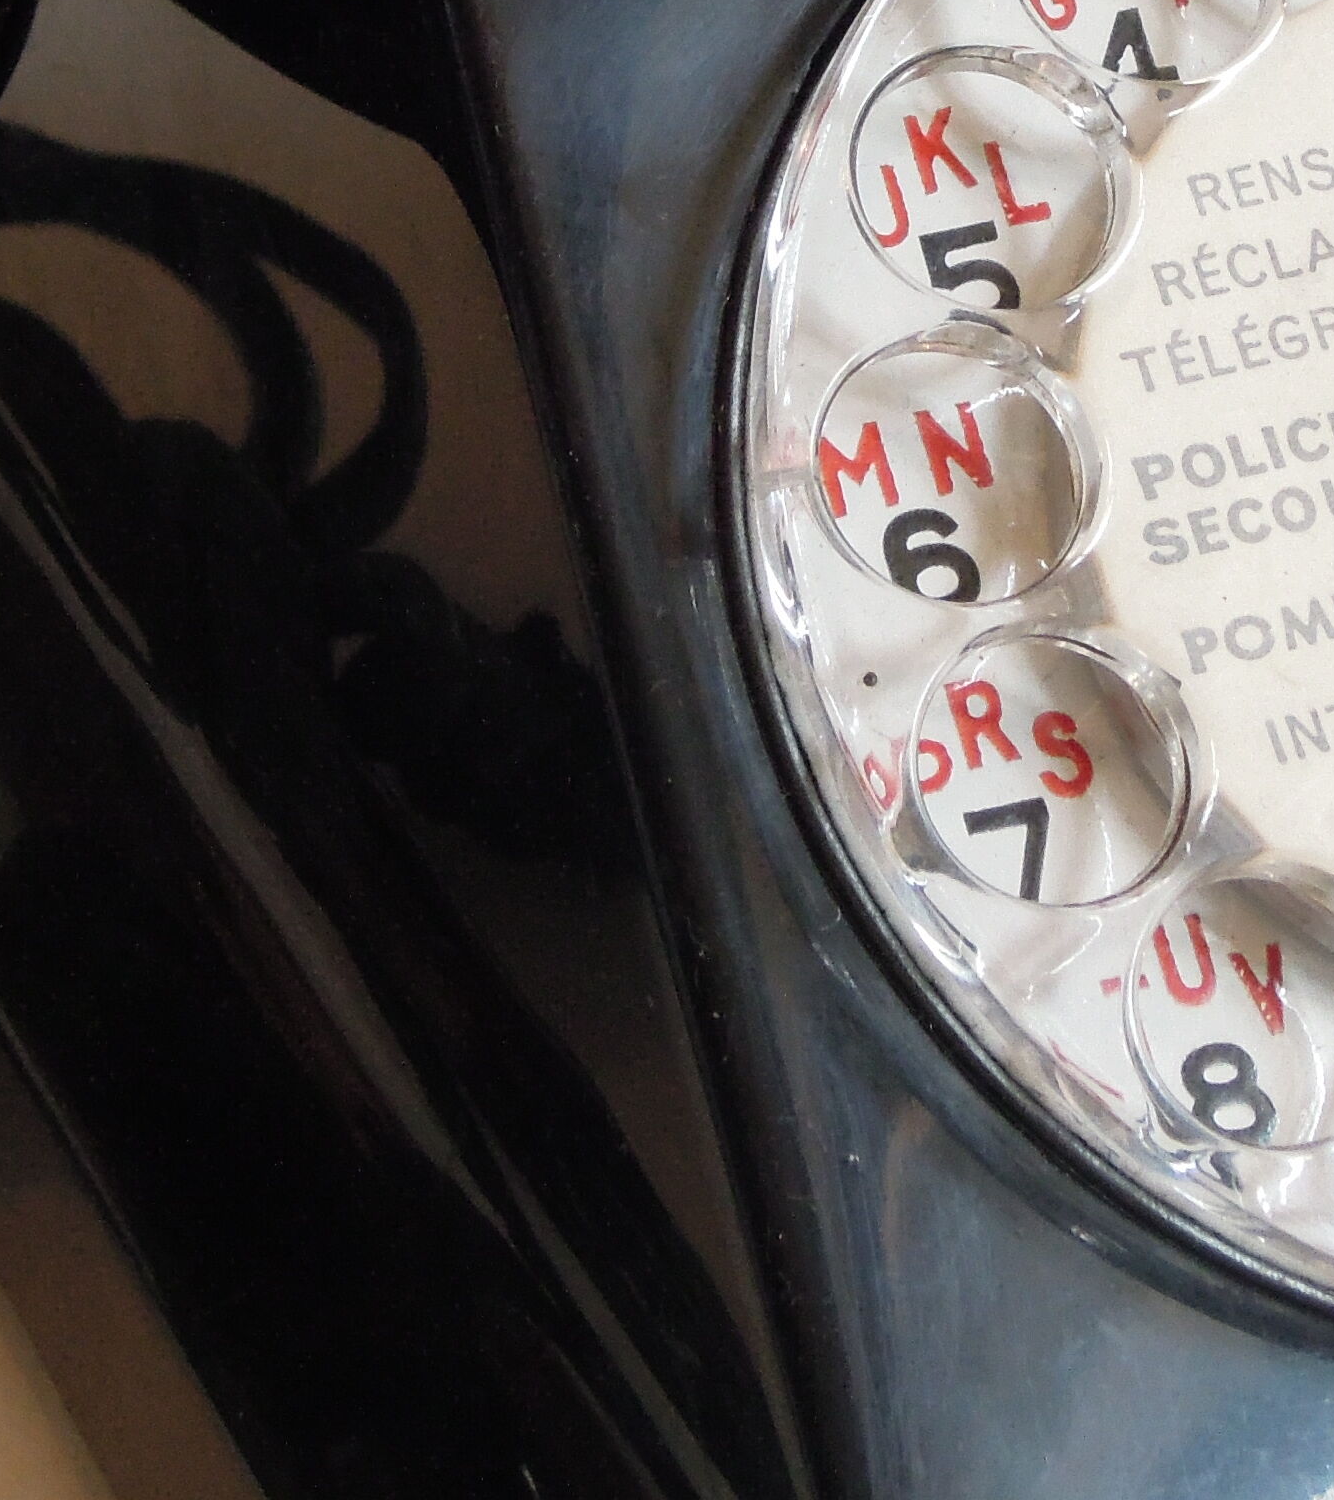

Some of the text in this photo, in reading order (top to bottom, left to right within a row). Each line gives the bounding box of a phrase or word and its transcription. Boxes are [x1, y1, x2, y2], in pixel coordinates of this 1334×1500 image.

[874, 105, 1052, 248] JKL
[919, 219, 1021, 311] 5
[817, 401, 994, 519] MN
[881, 507, 982, 603] 6
[962, 796, 1050, 903] 7
[1180, 1041, 1278, 1146] 8
